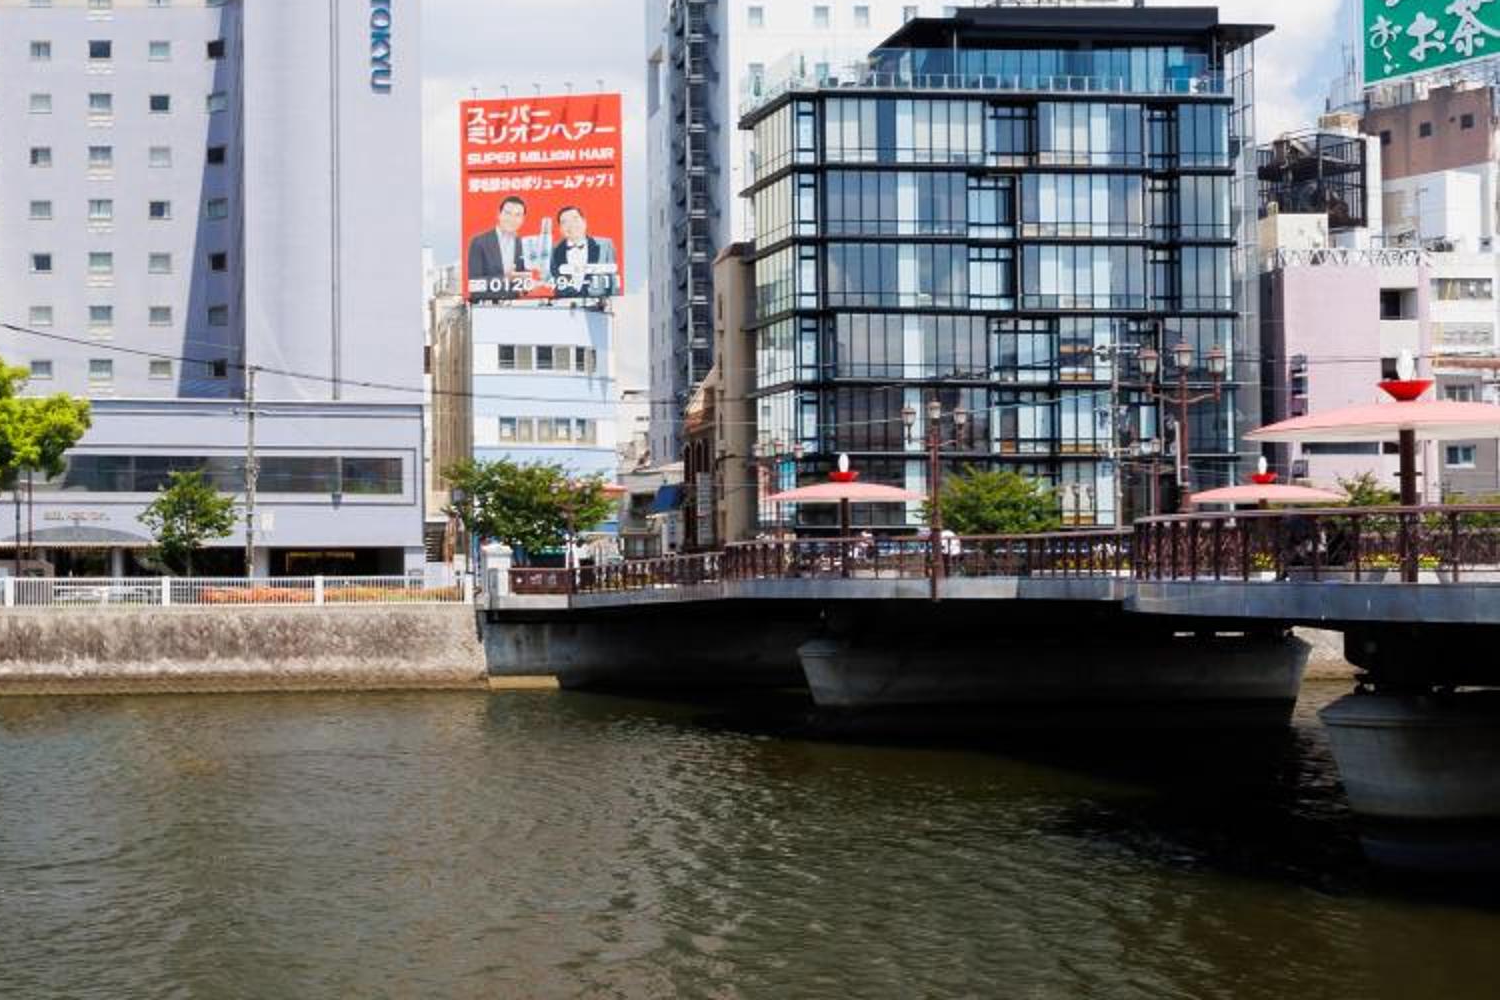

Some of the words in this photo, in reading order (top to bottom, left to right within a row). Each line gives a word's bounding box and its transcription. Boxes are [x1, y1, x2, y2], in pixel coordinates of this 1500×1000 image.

[467, 105, 551, 124] スーパー
[467, 121, 616, 145] ミリオンヘアー
[467, 151, 517, 165] SUPER
[520, 149, 576, 163] MILLION
[579, 147, 615, 160] HAIR
